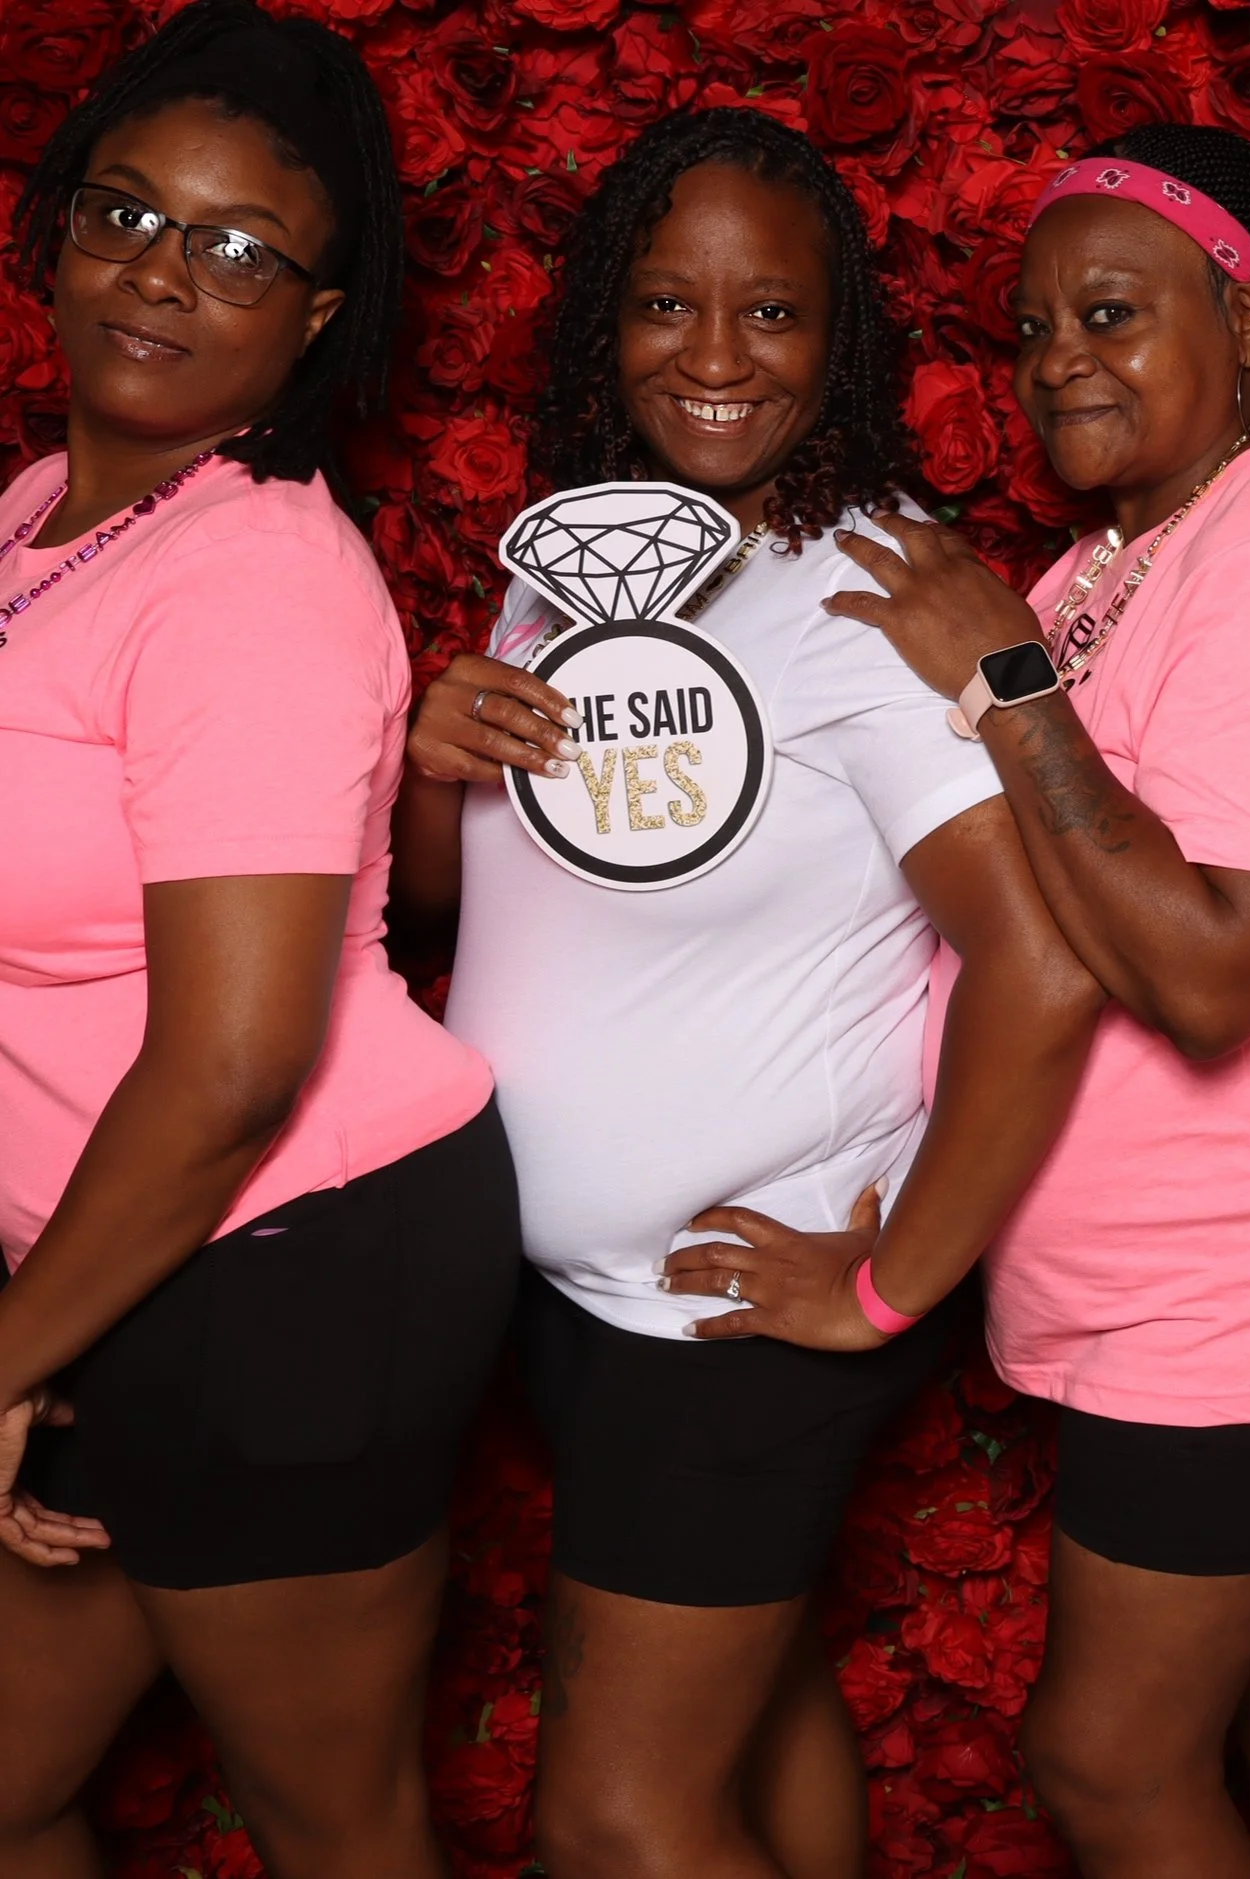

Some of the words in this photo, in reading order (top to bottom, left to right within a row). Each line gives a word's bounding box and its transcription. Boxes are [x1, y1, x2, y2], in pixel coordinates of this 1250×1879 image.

[566, 694, 618, 743] HE
[627, 686, 714, 739] SAID
[576, 740, 707, 835] YES
